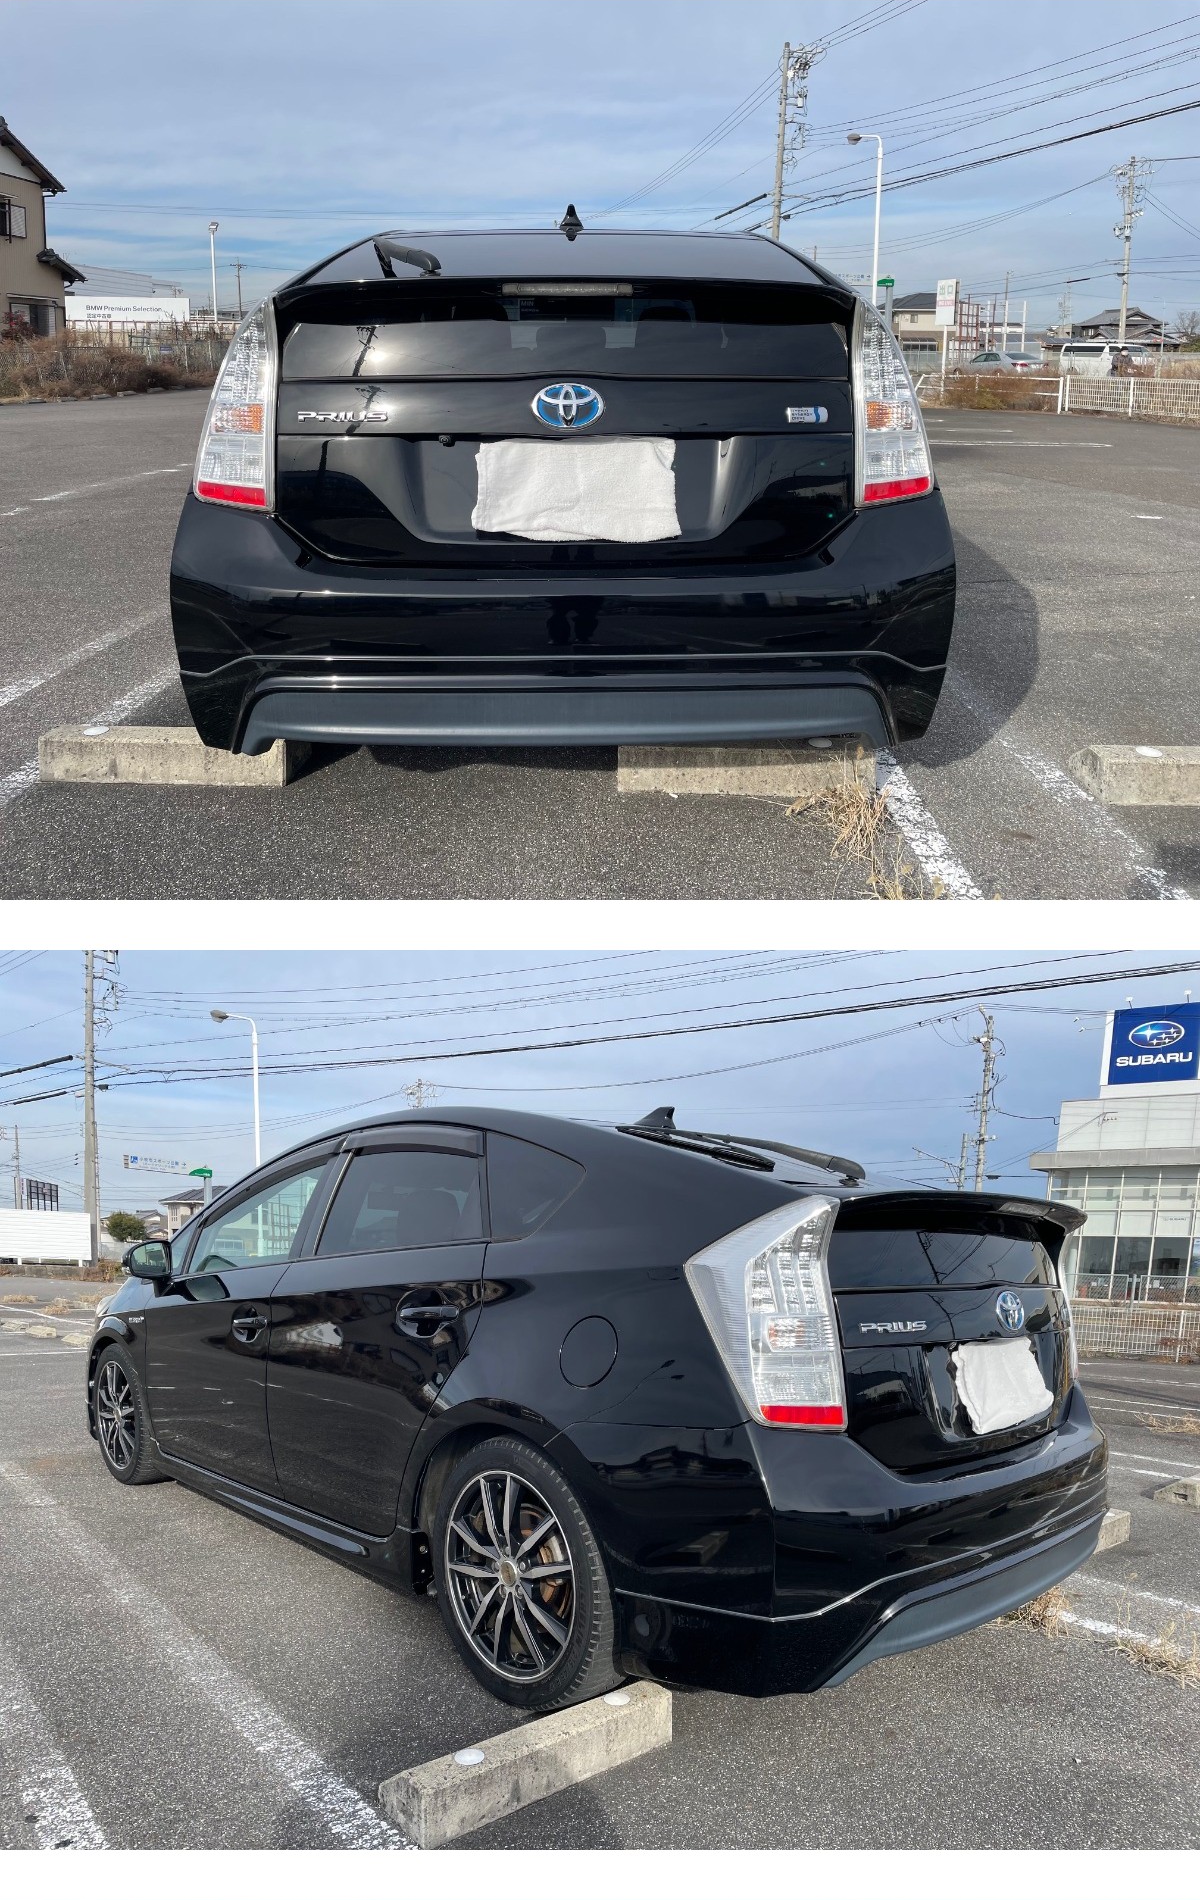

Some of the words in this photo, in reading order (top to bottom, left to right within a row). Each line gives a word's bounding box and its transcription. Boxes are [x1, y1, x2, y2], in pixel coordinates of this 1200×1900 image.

[297, 411, 389, 423] PRIUS
[1116, 1052, 1193, 1067] SUBARU
[860, 1320, 928, 1334] PRIUS
